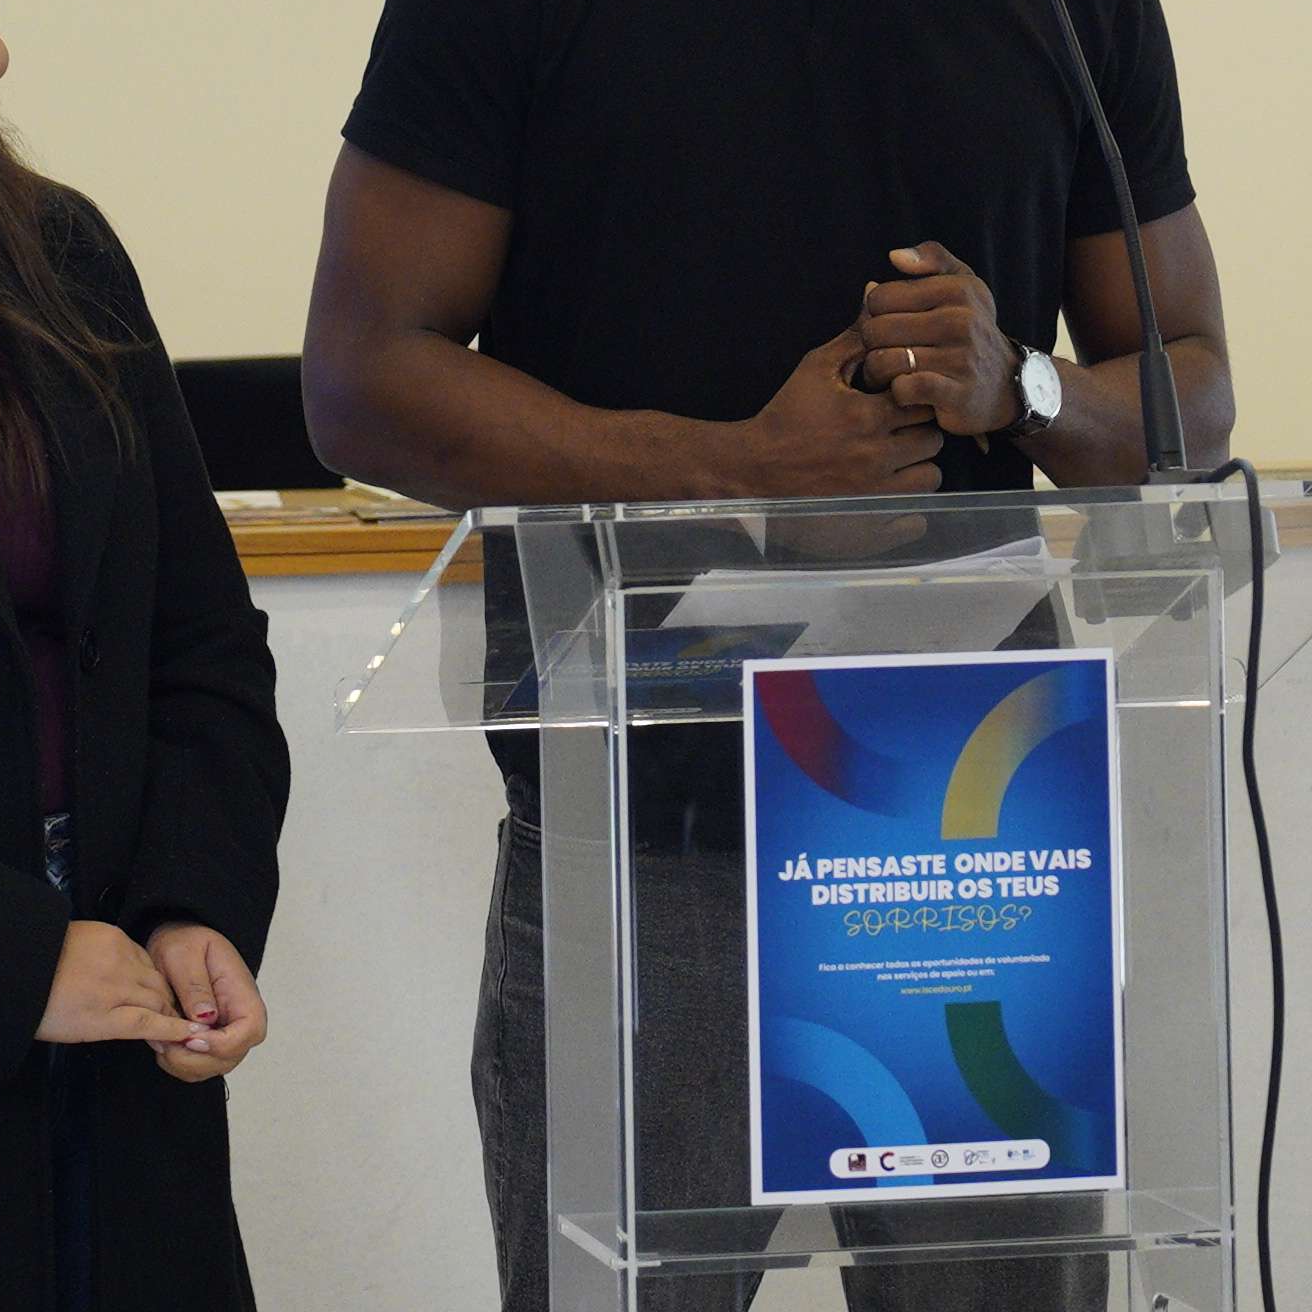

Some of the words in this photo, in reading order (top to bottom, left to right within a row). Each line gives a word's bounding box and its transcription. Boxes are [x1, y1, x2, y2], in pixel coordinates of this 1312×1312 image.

[778, 852, 813, 881] JÁ
[816, 854, 947, 879] PENSASTE
[954, 851, 1026, 874] ONDE
[1029, 848, 1092, 870] VAIS
[811, 879, 954, 905] DISTRIBUIR
[957, 877, 993, 898] OS
[996, 875, 1060, 897] TEUS
[843, 904, 1032, 936] SORRISOS?
